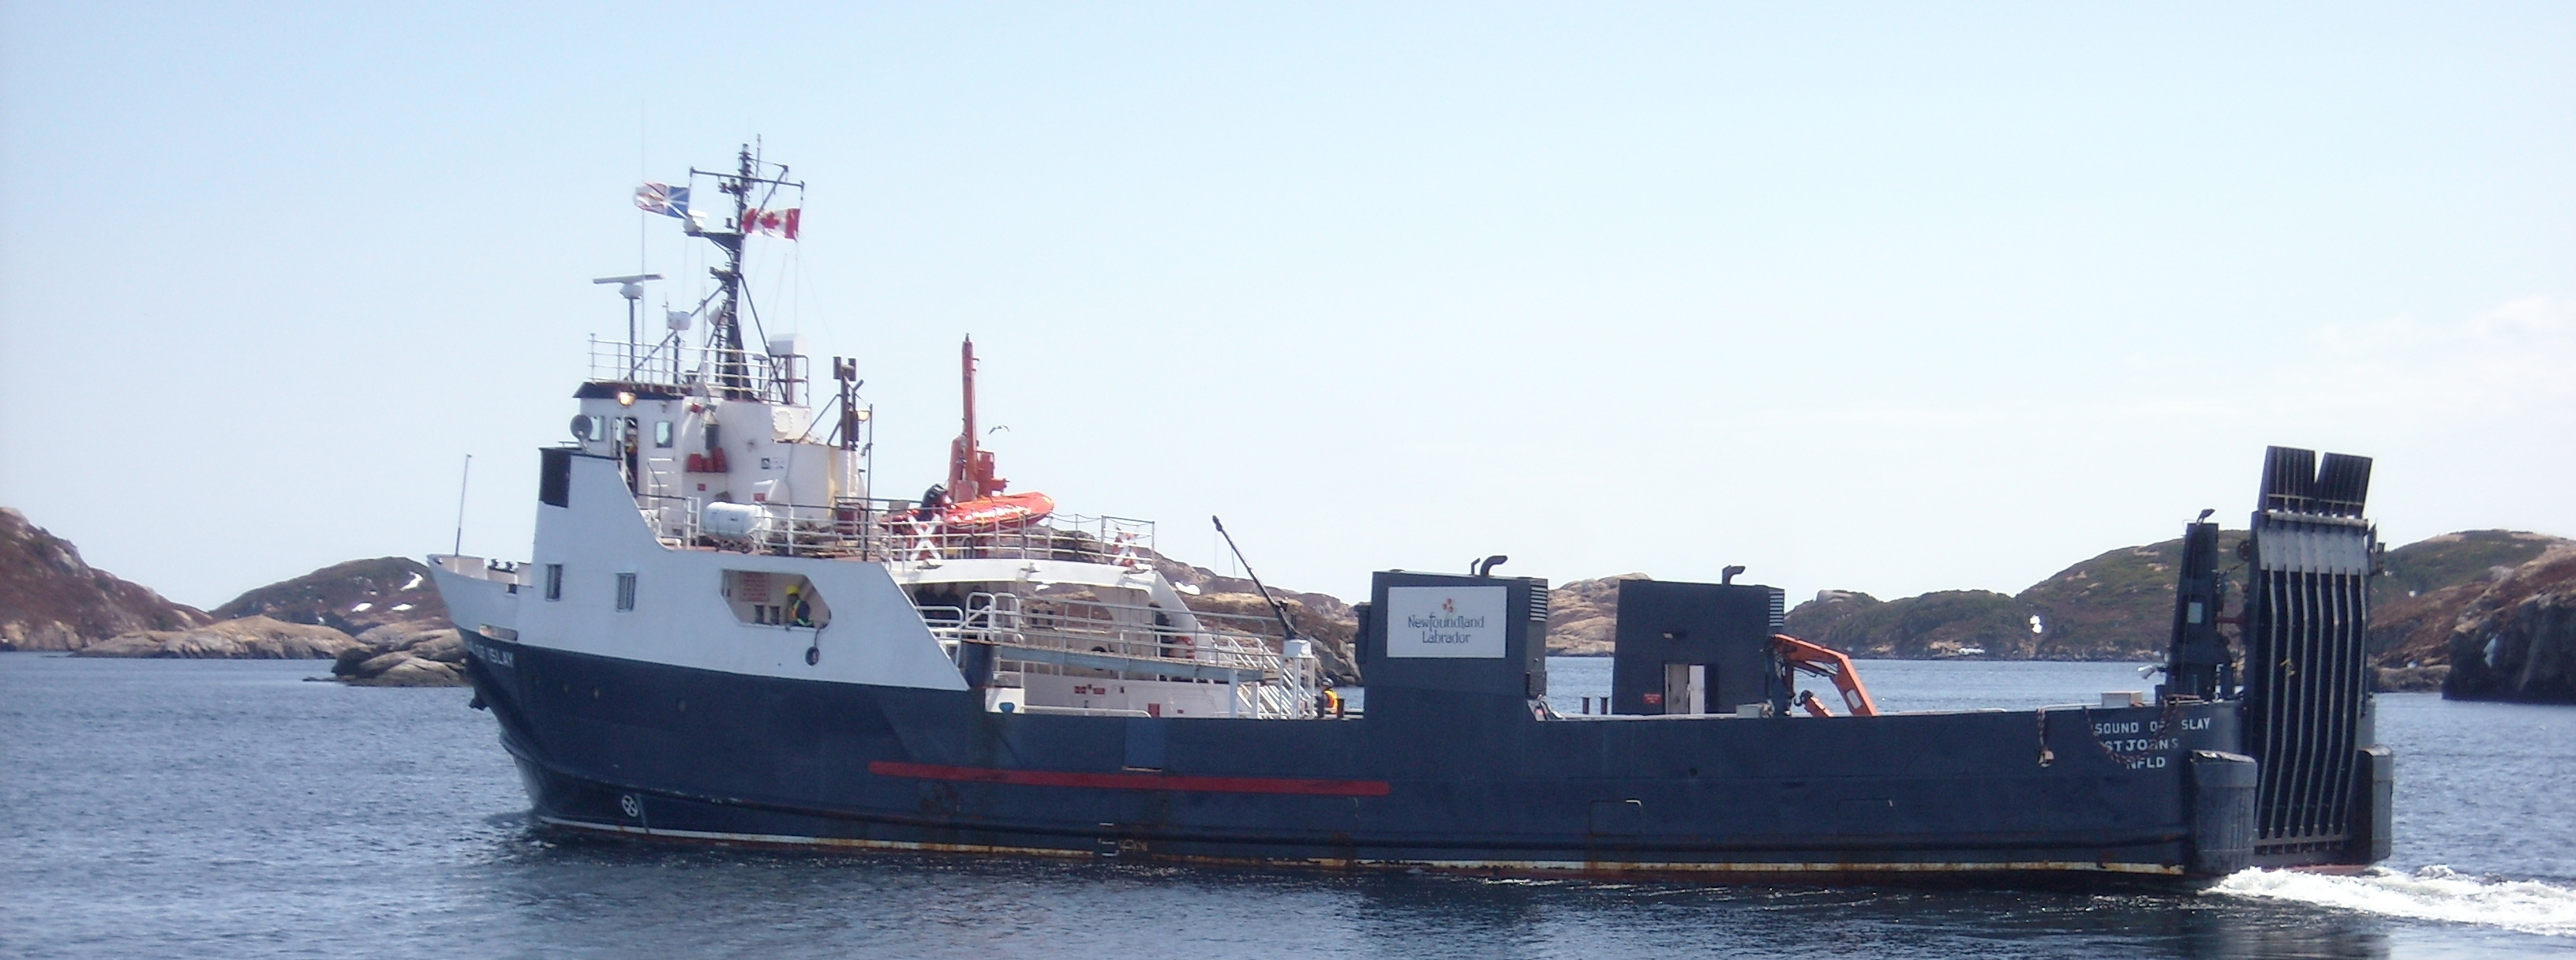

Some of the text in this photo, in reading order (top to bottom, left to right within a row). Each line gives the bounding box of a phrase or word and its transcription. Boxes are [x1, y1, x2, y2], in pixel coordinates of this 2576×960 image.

[1408, 612, 1484, 632] Newfoundland
[1422, 630, 1471, 643] Labrador
[2095, 722, 2139, 734] SOUND
[2105, 740, 2122, 752] ST
